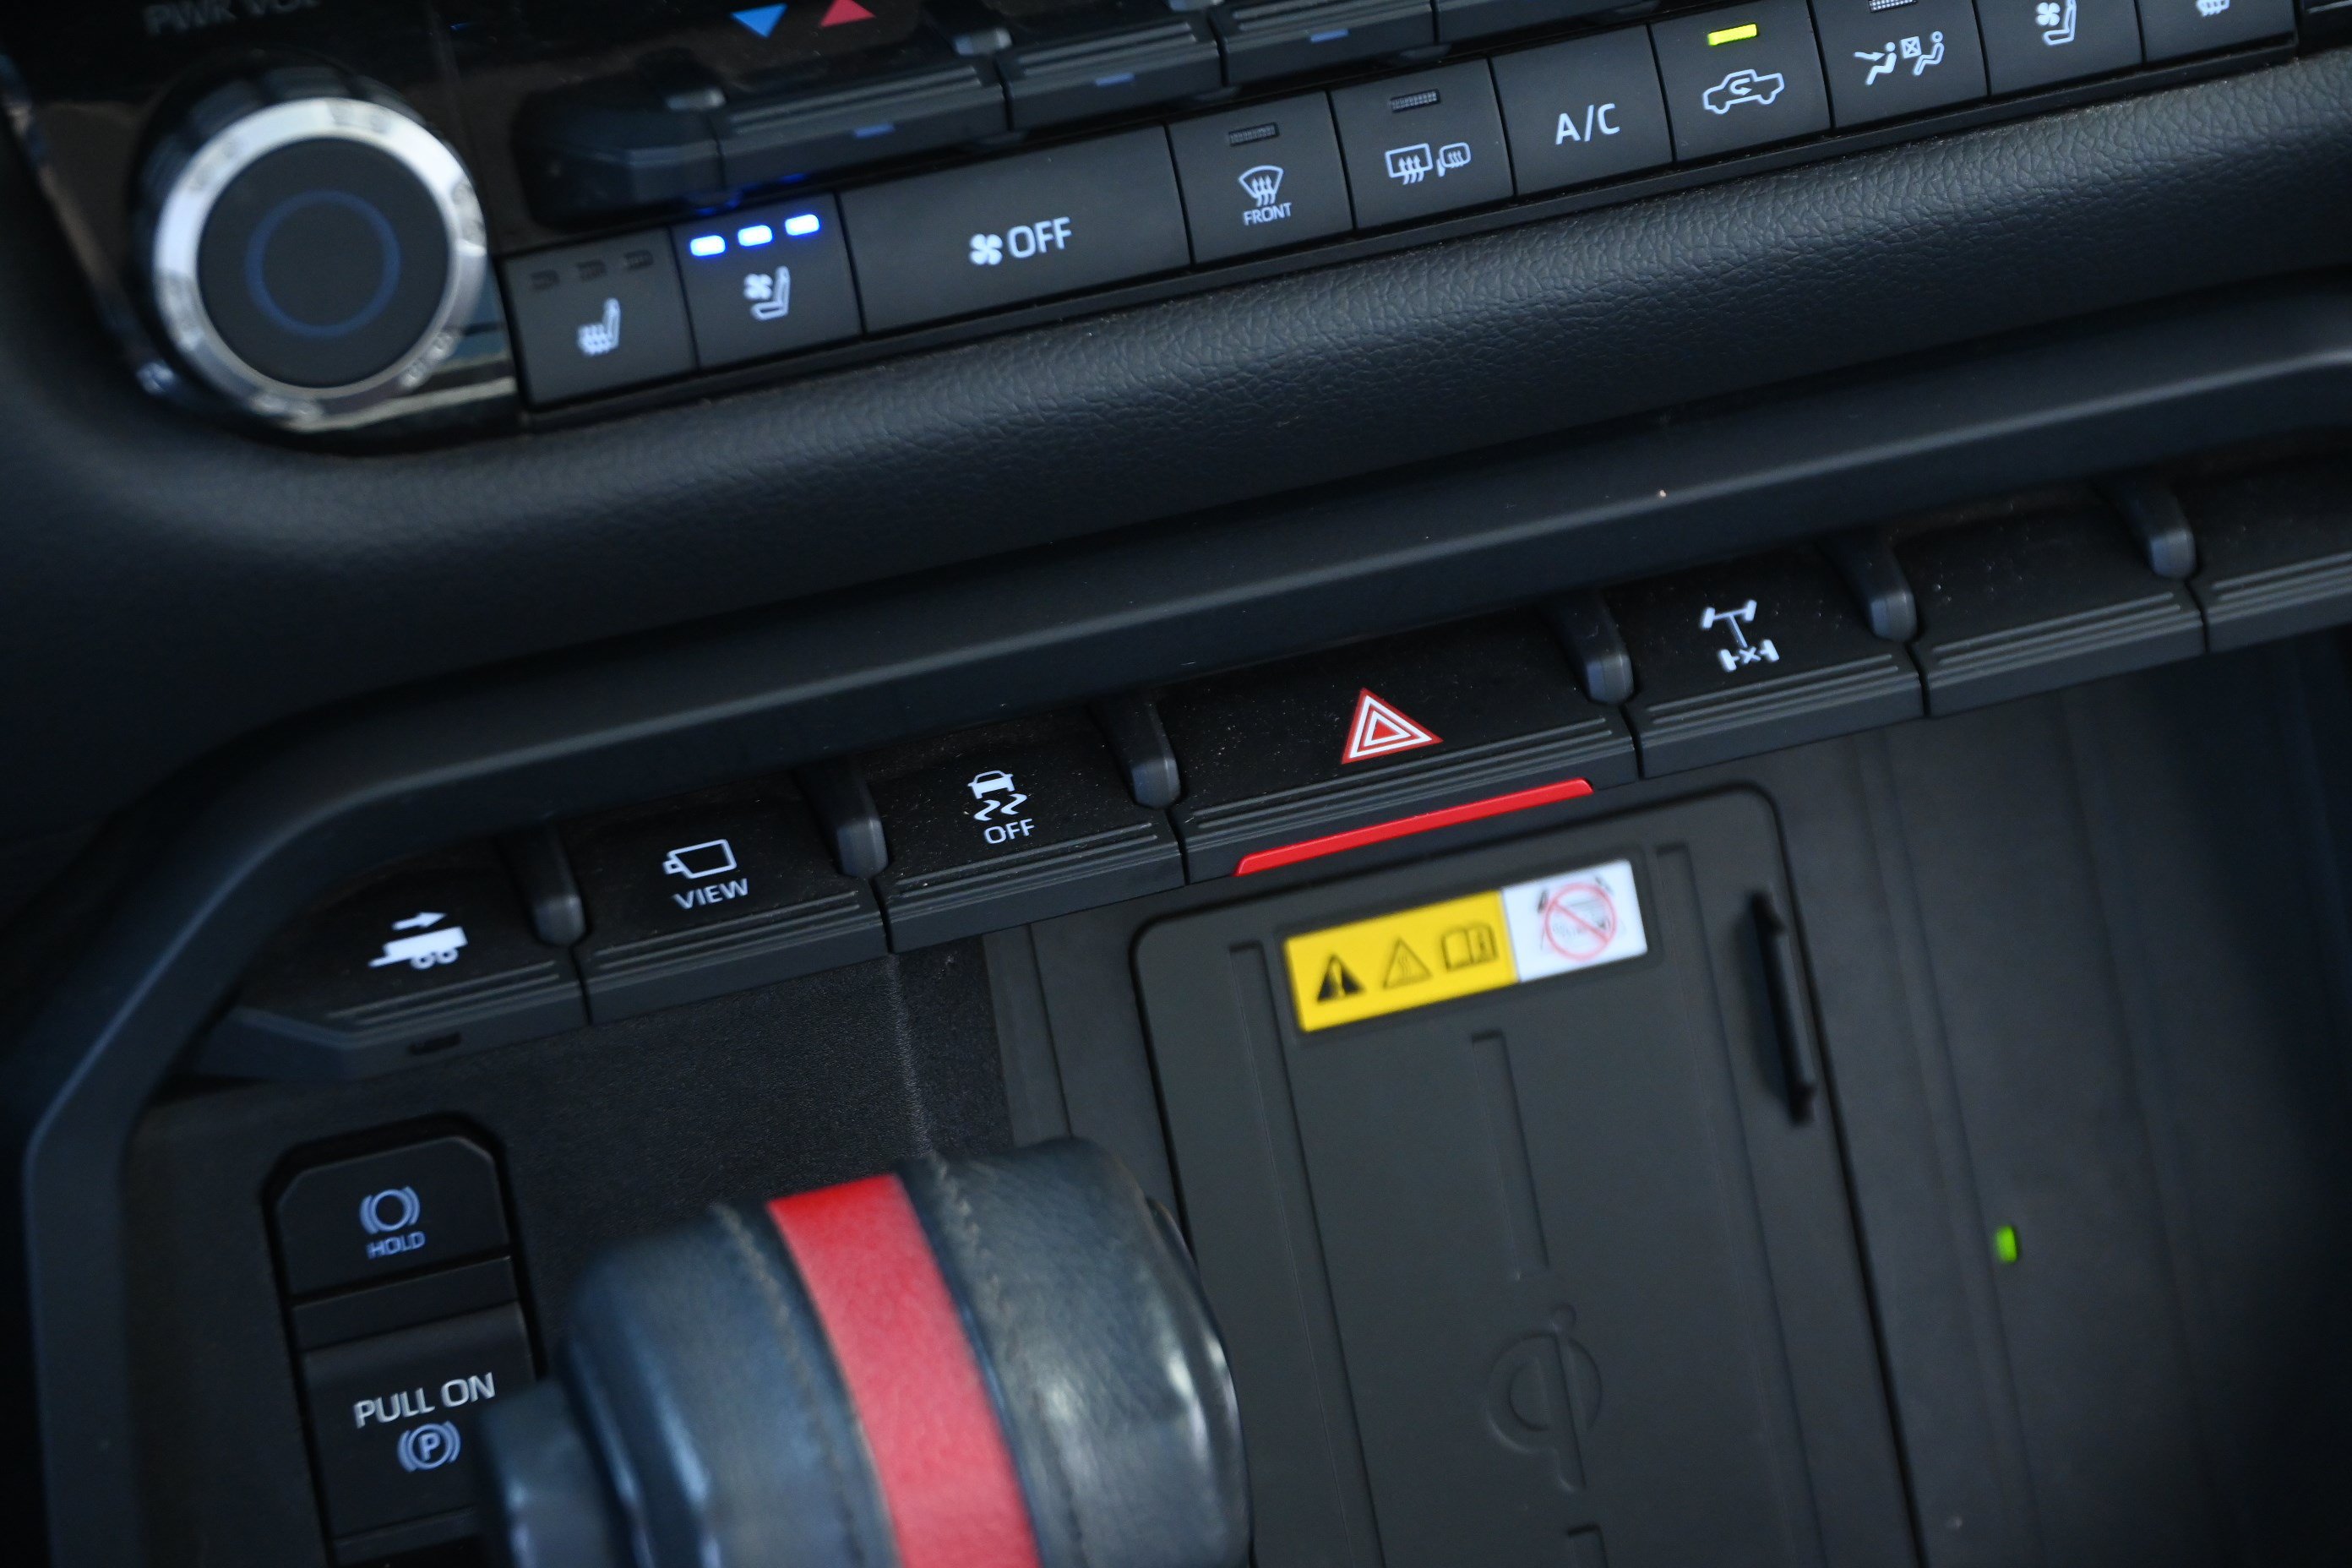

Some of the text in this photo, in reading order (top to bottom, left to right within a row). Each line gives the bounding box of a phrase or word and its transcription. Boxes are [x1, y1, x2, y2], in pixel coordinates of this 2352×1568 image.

[1555, 102, 1620, 145] A/C
[1243, 202, 1293, 226] FRONT
[1007, 216, 1072, 259] OFF
[983, 818, 1035, 844] OFF
[672, 878, 749, 910] VIEW
[366, 1231, 426, 1260] HOLD
[353, 1371, 496, 1429] PULL ON
[418, 1432, 441, 1461] P
